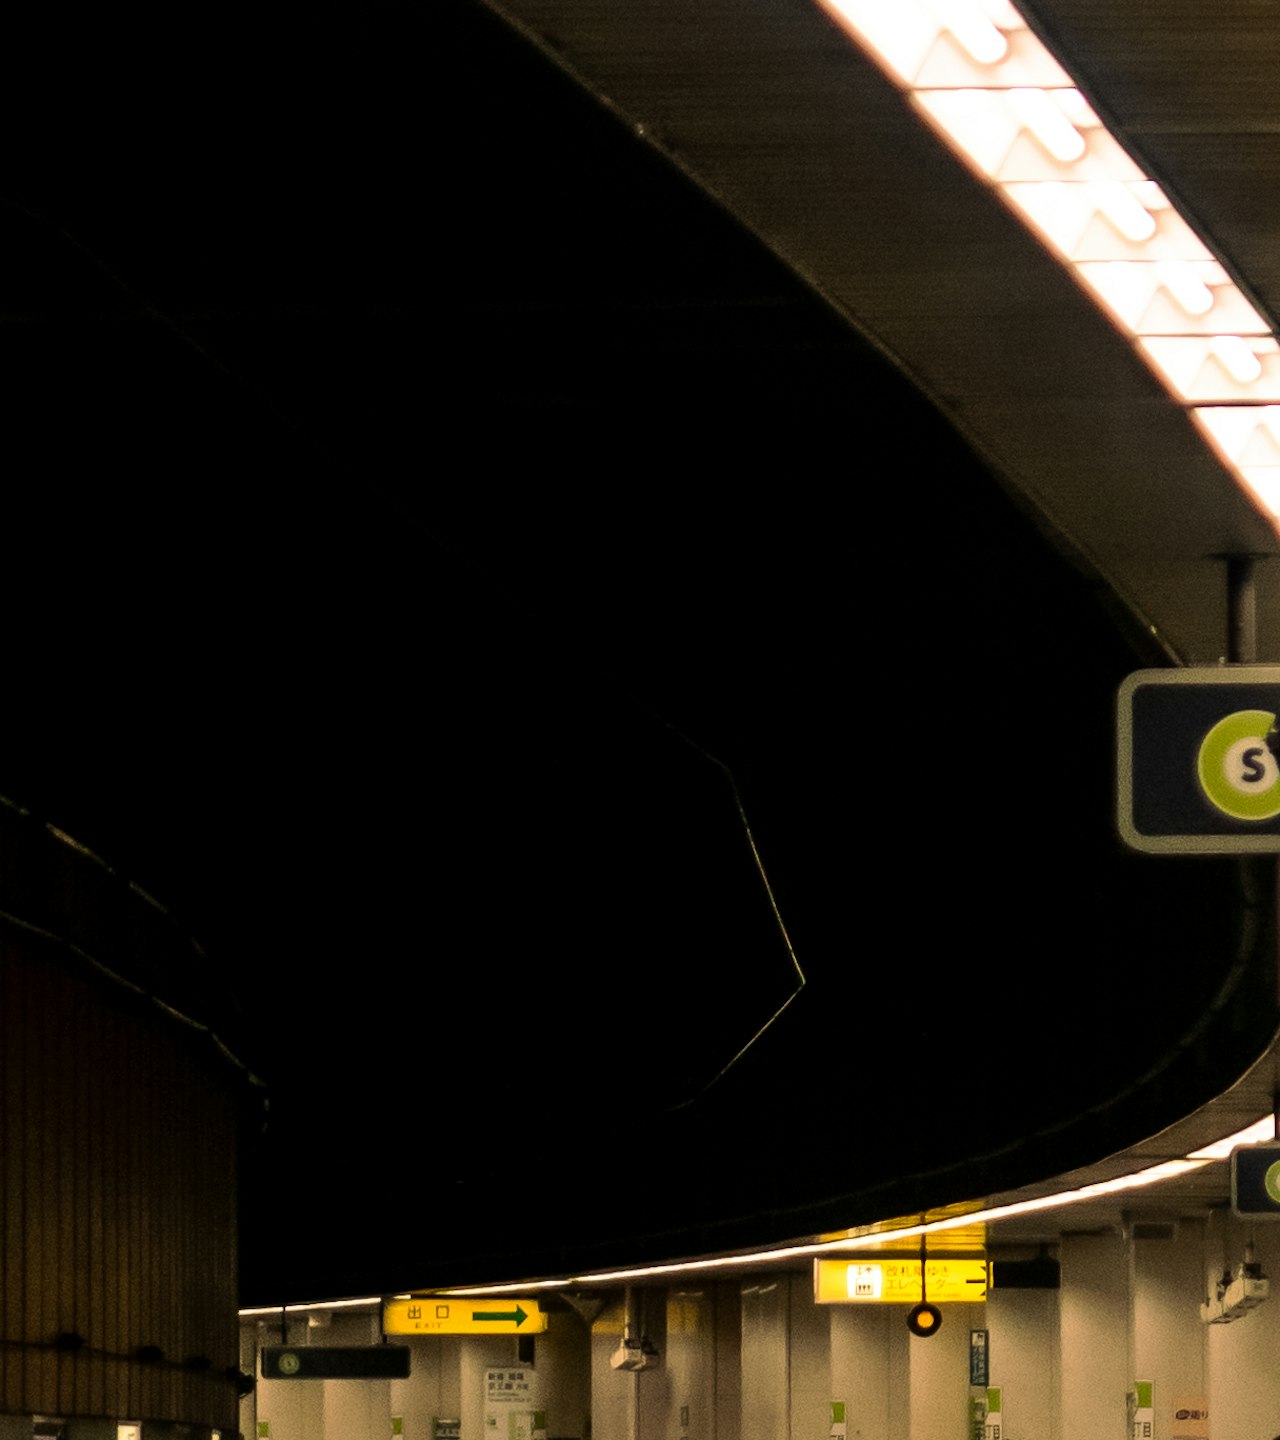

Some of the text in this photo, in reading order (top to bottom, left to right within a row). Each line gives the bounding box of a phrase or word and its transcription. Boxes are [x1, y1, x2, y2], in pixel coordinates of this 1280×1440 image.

[1242, 748, 1264, 783] S
[407, 1305, 450, 1320] 出口
[415, 1321, 442, 1330] EXIT
